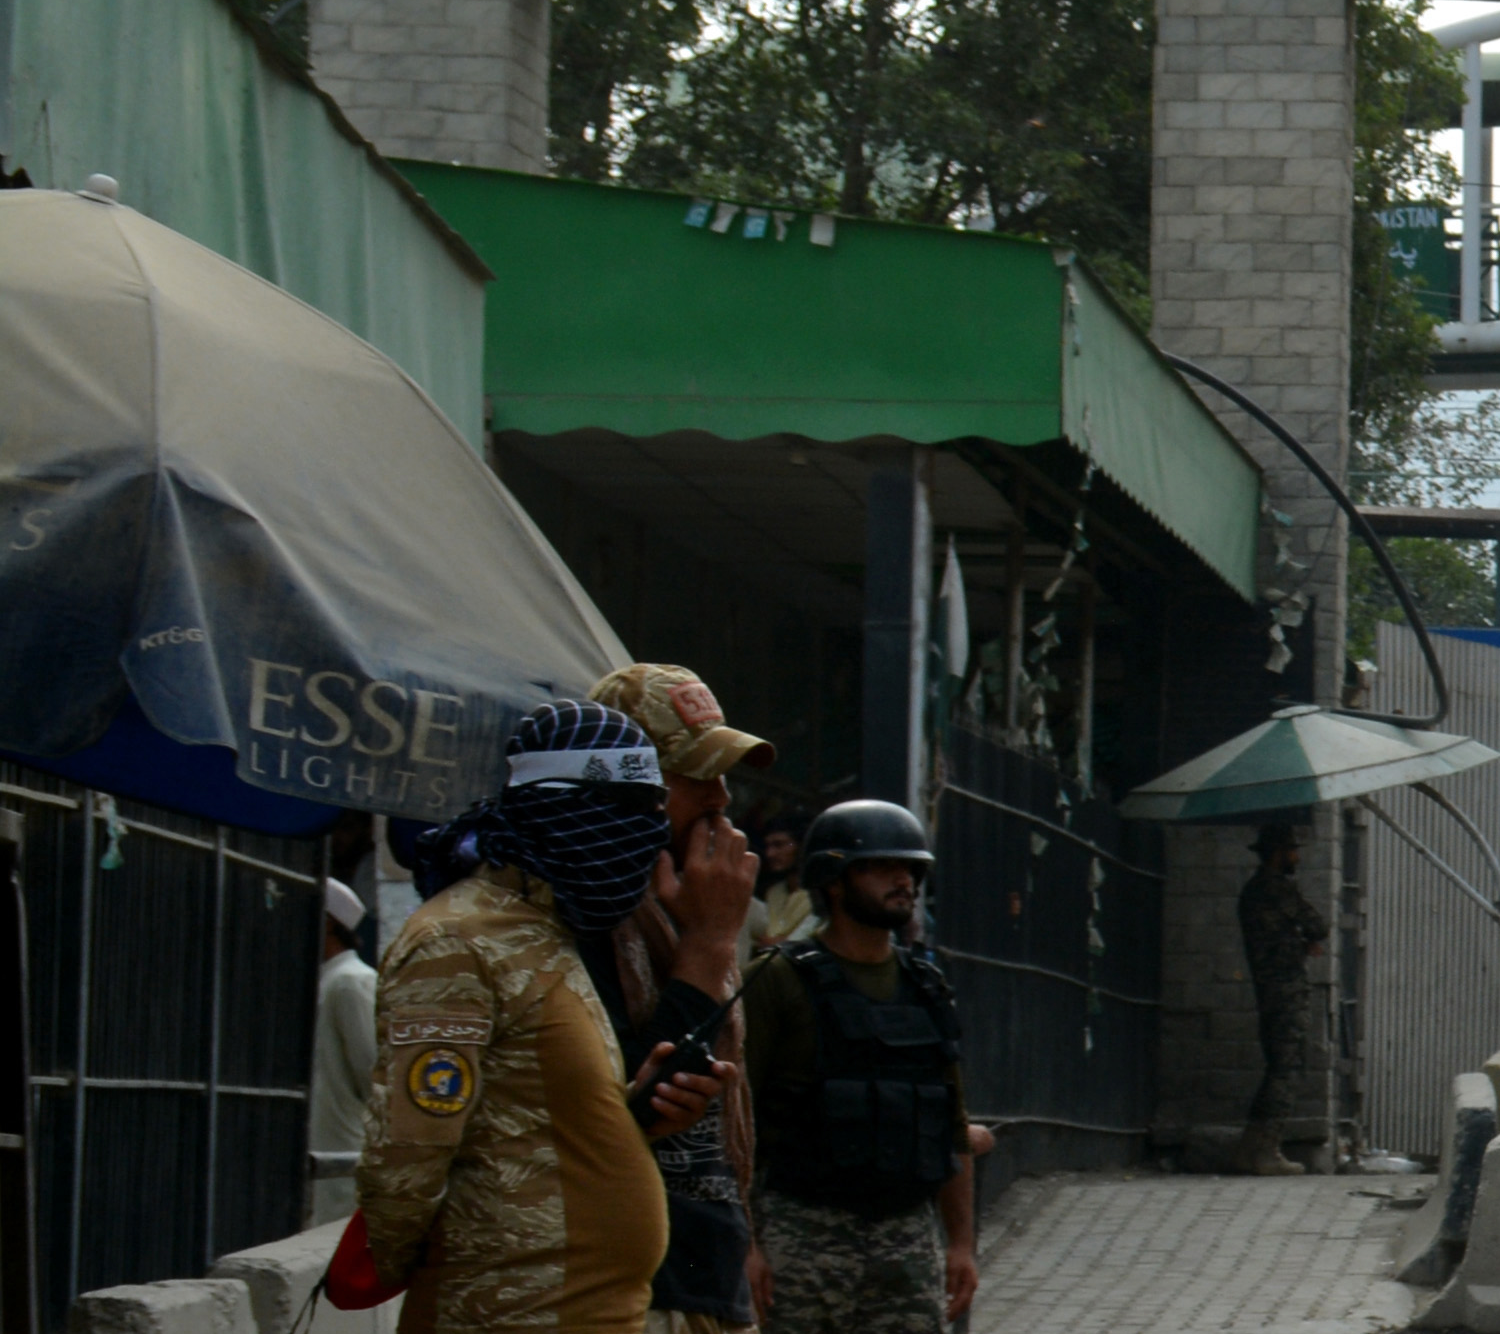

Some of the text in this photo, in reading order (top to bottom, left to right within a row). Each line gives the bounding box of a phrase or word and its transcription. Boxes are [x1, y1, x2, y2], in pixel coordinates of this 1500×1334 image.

[138, 625, 204, 651] KT&G
[249, 658, 464, 767] ESSE
[250, 741, 450, 809] LIGHTS
